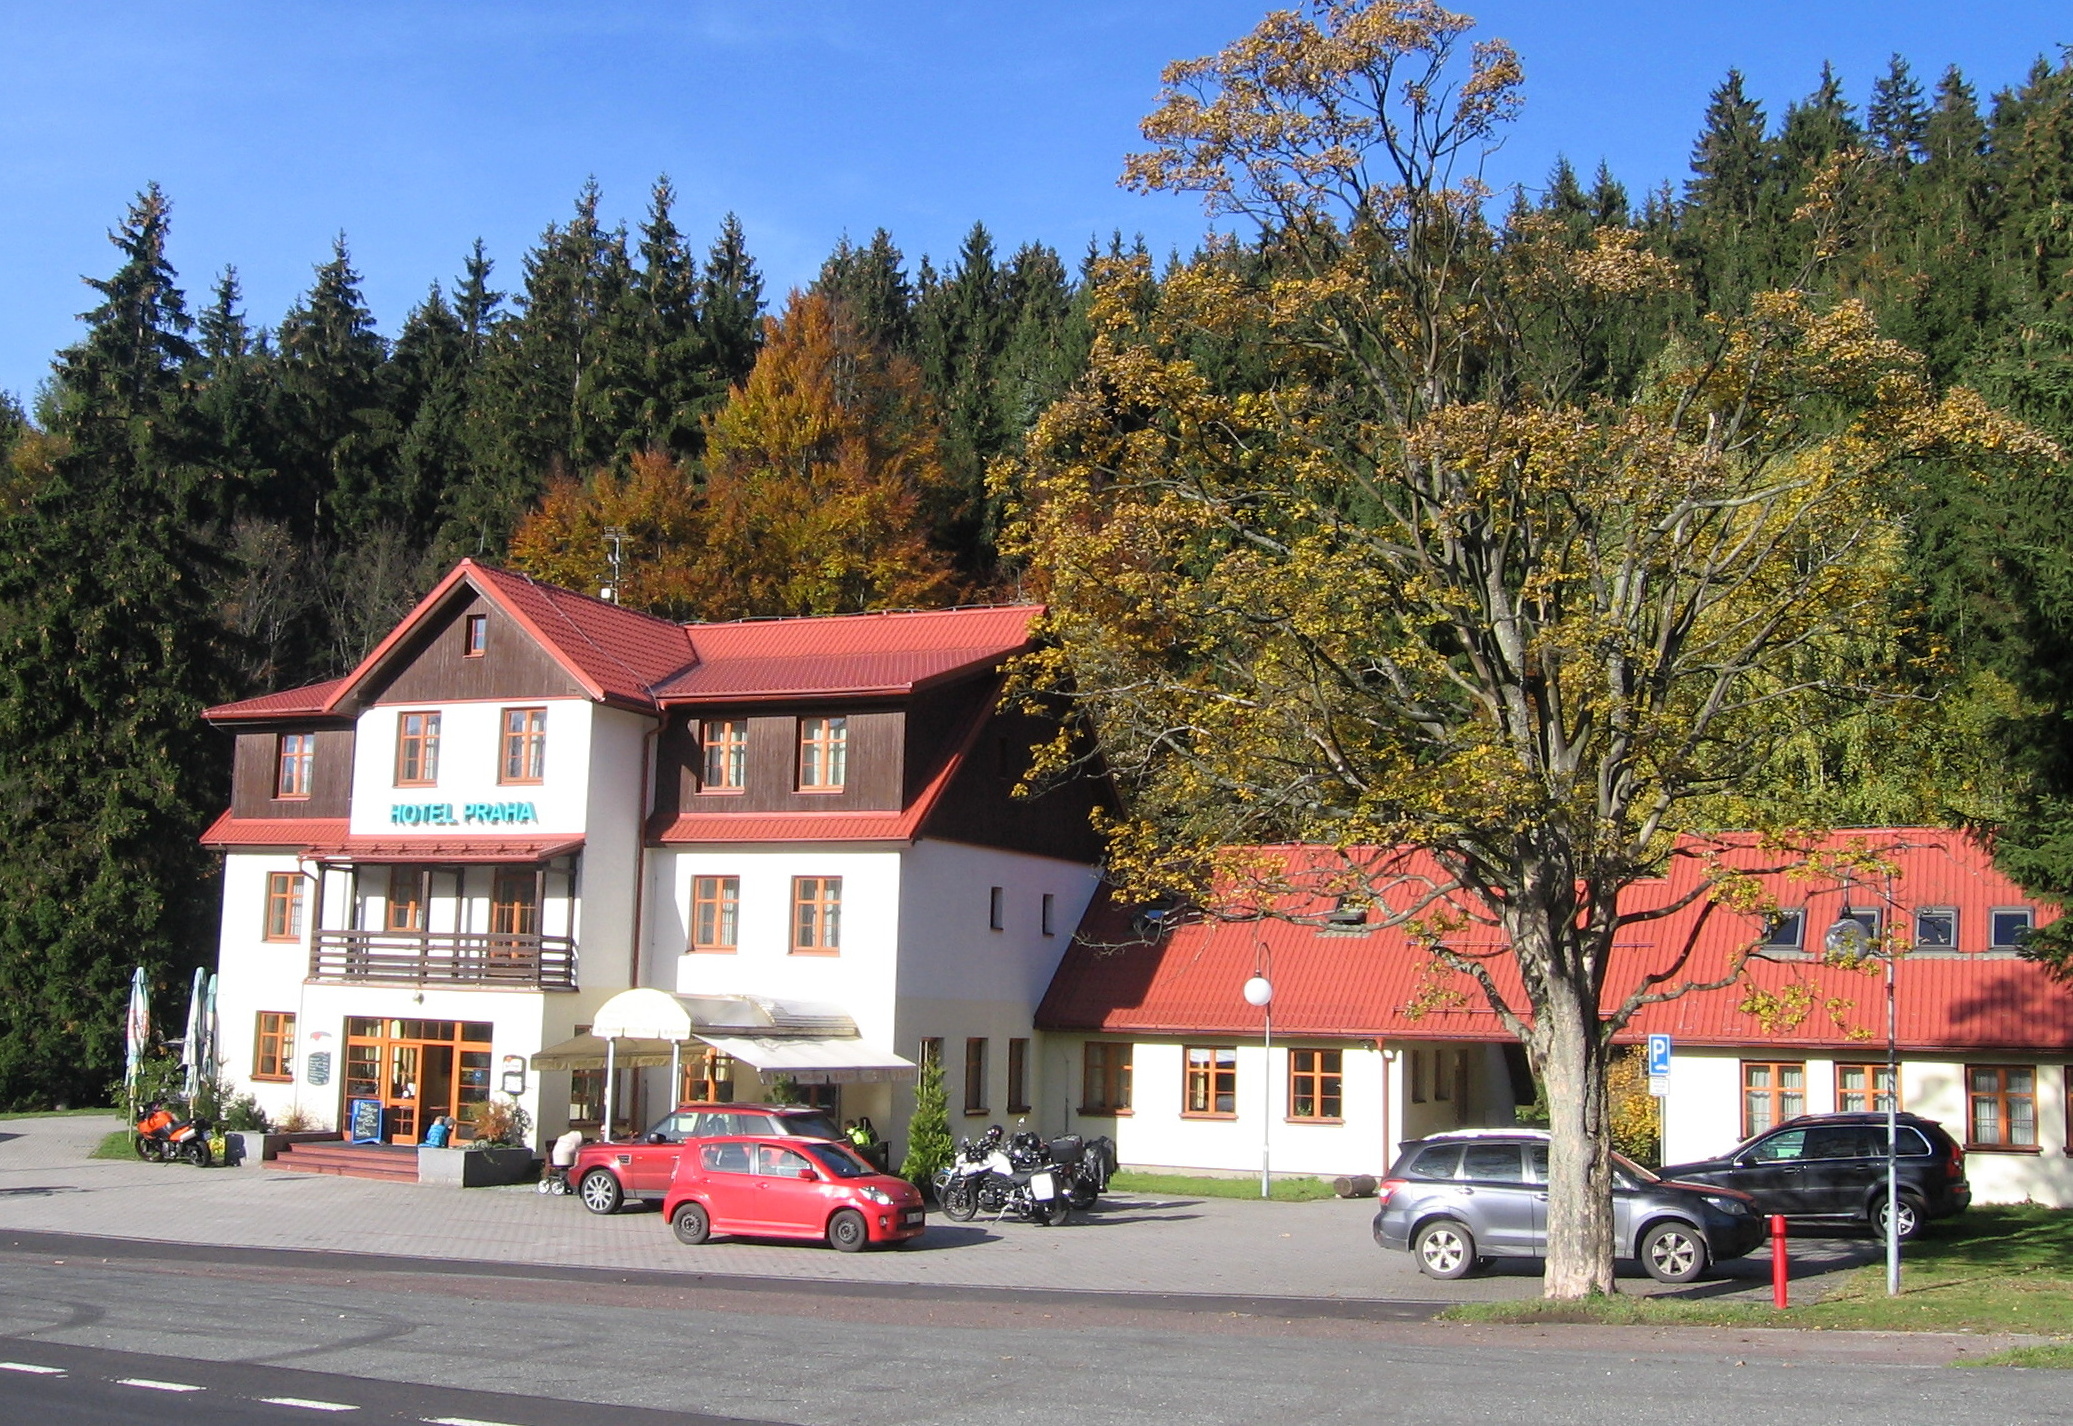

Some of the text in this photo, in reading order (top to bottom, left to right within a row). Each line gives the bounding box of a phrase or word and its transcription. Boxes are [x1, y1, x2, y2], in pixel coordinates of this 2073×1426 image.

[390, 802, 538, 825] HOTEL PRAHA
[1653, 1039, 1666, 1063] P
